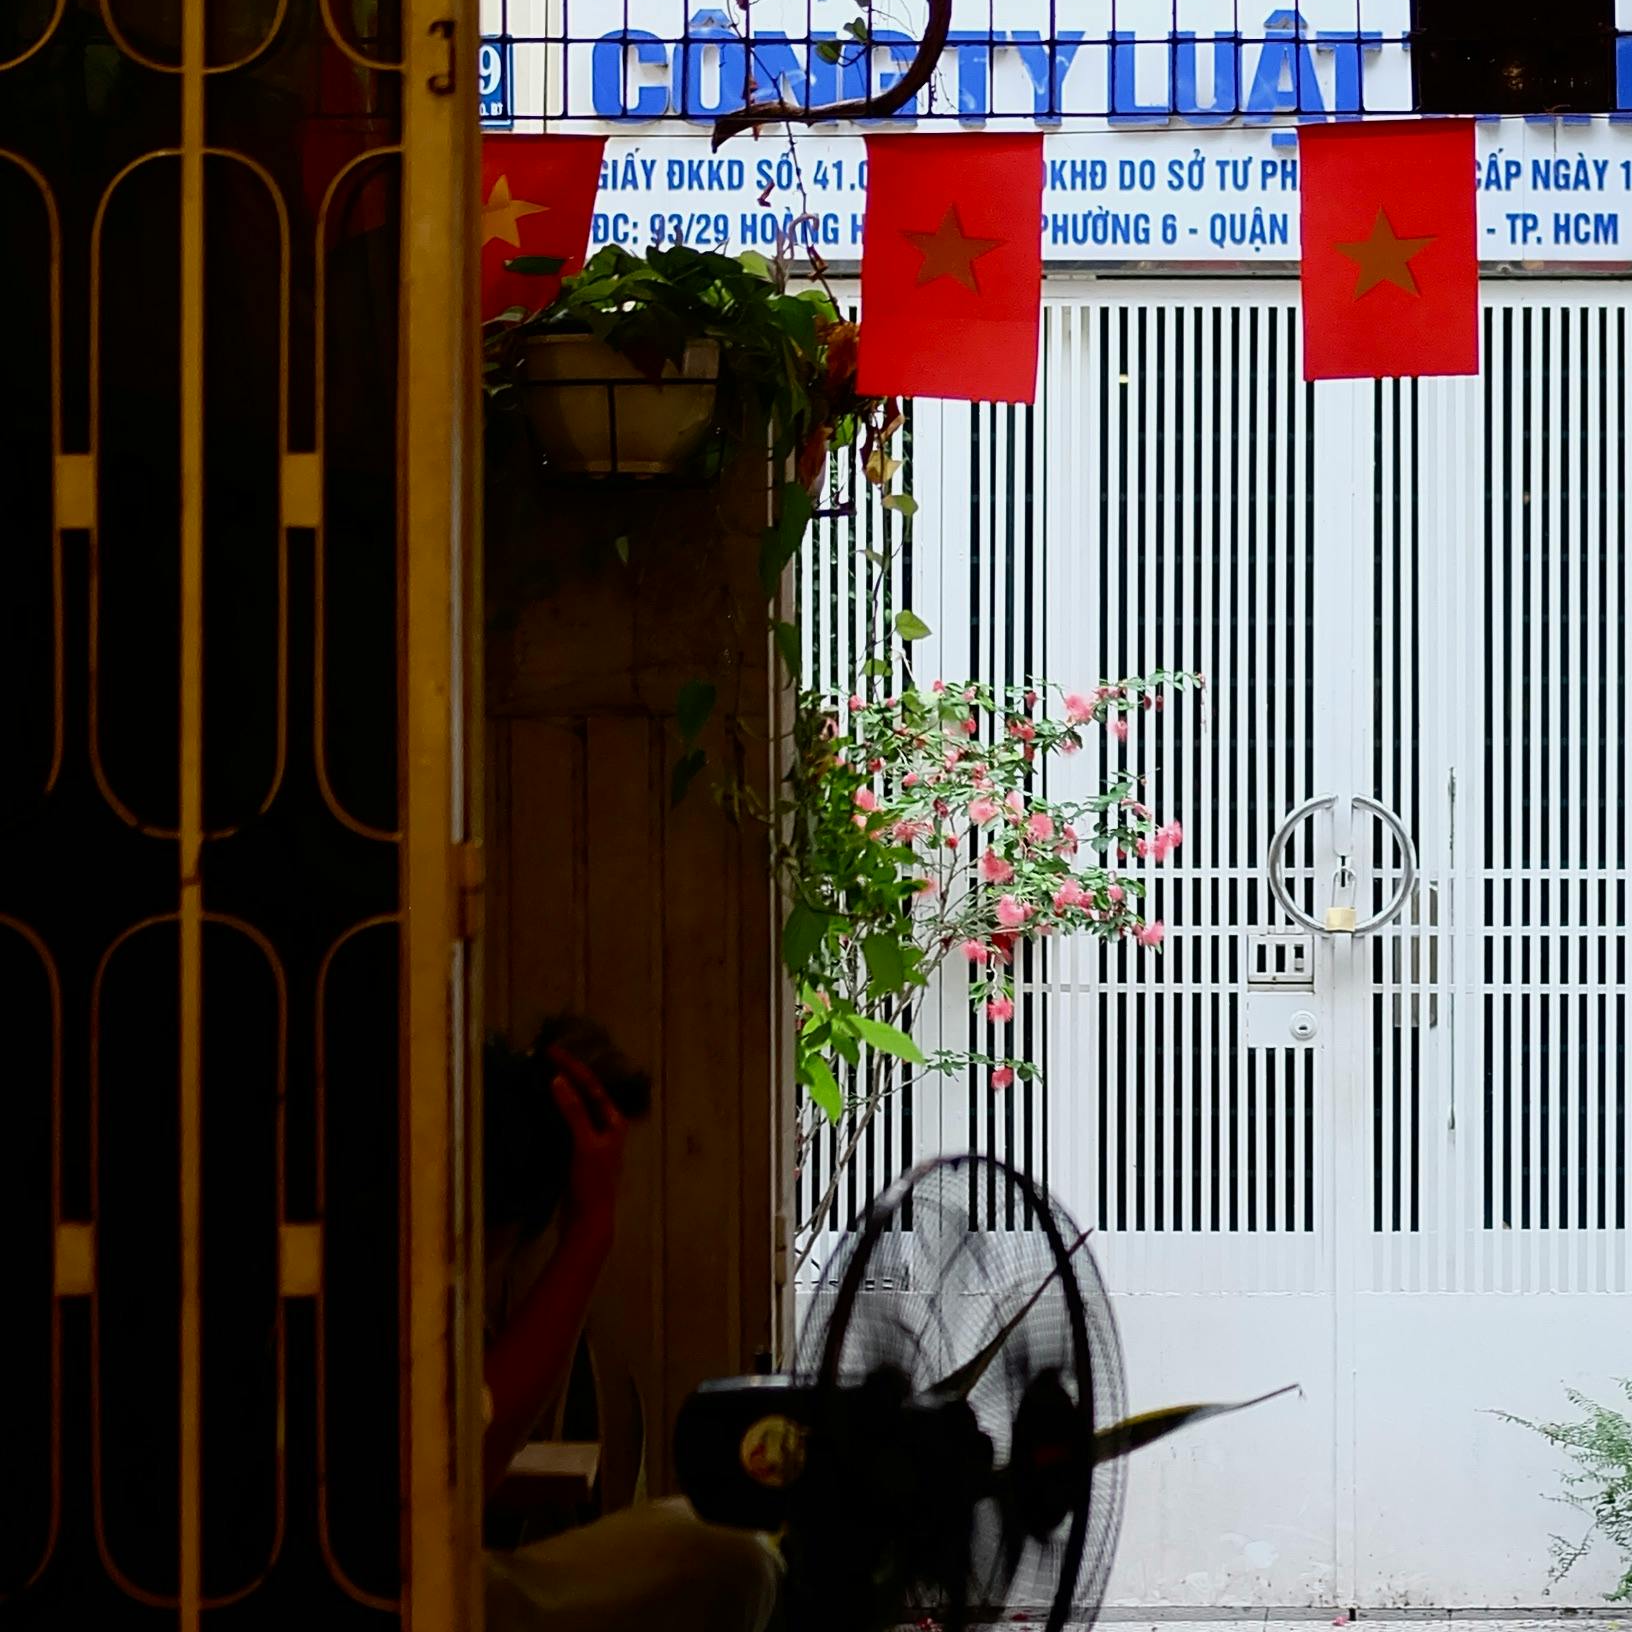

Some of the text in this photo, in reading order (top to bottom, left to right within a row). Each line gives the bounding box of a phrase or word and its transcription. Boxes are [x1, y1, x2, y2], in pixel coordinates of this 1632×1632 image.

[591, 8, 918, 126] CÔNG
[942, 30, 1086, 127] TY
[1107, 8, 1383, 147] LUẬT
[667, 159, 745, 192] ĐKKD
[1042, 159, 1107, 192] KHĐ
[1119, 159, 1156, 192] DO
[1167, 148, 1206, 192] SỞ
[1215, 156, 1253, 192] TƯ
[1531, 153, 1609, 192] NGÀY
[592, 213, 639, 245] ĐC:
[650, 213, 730, 245] 93/29
[1161, 213, 1178, 246] 6
[1209, 206, 1289, 253] QUẬN
[1505, 213, 1543, 245] TP.
[1553, 213, 1619, 245] HCM
